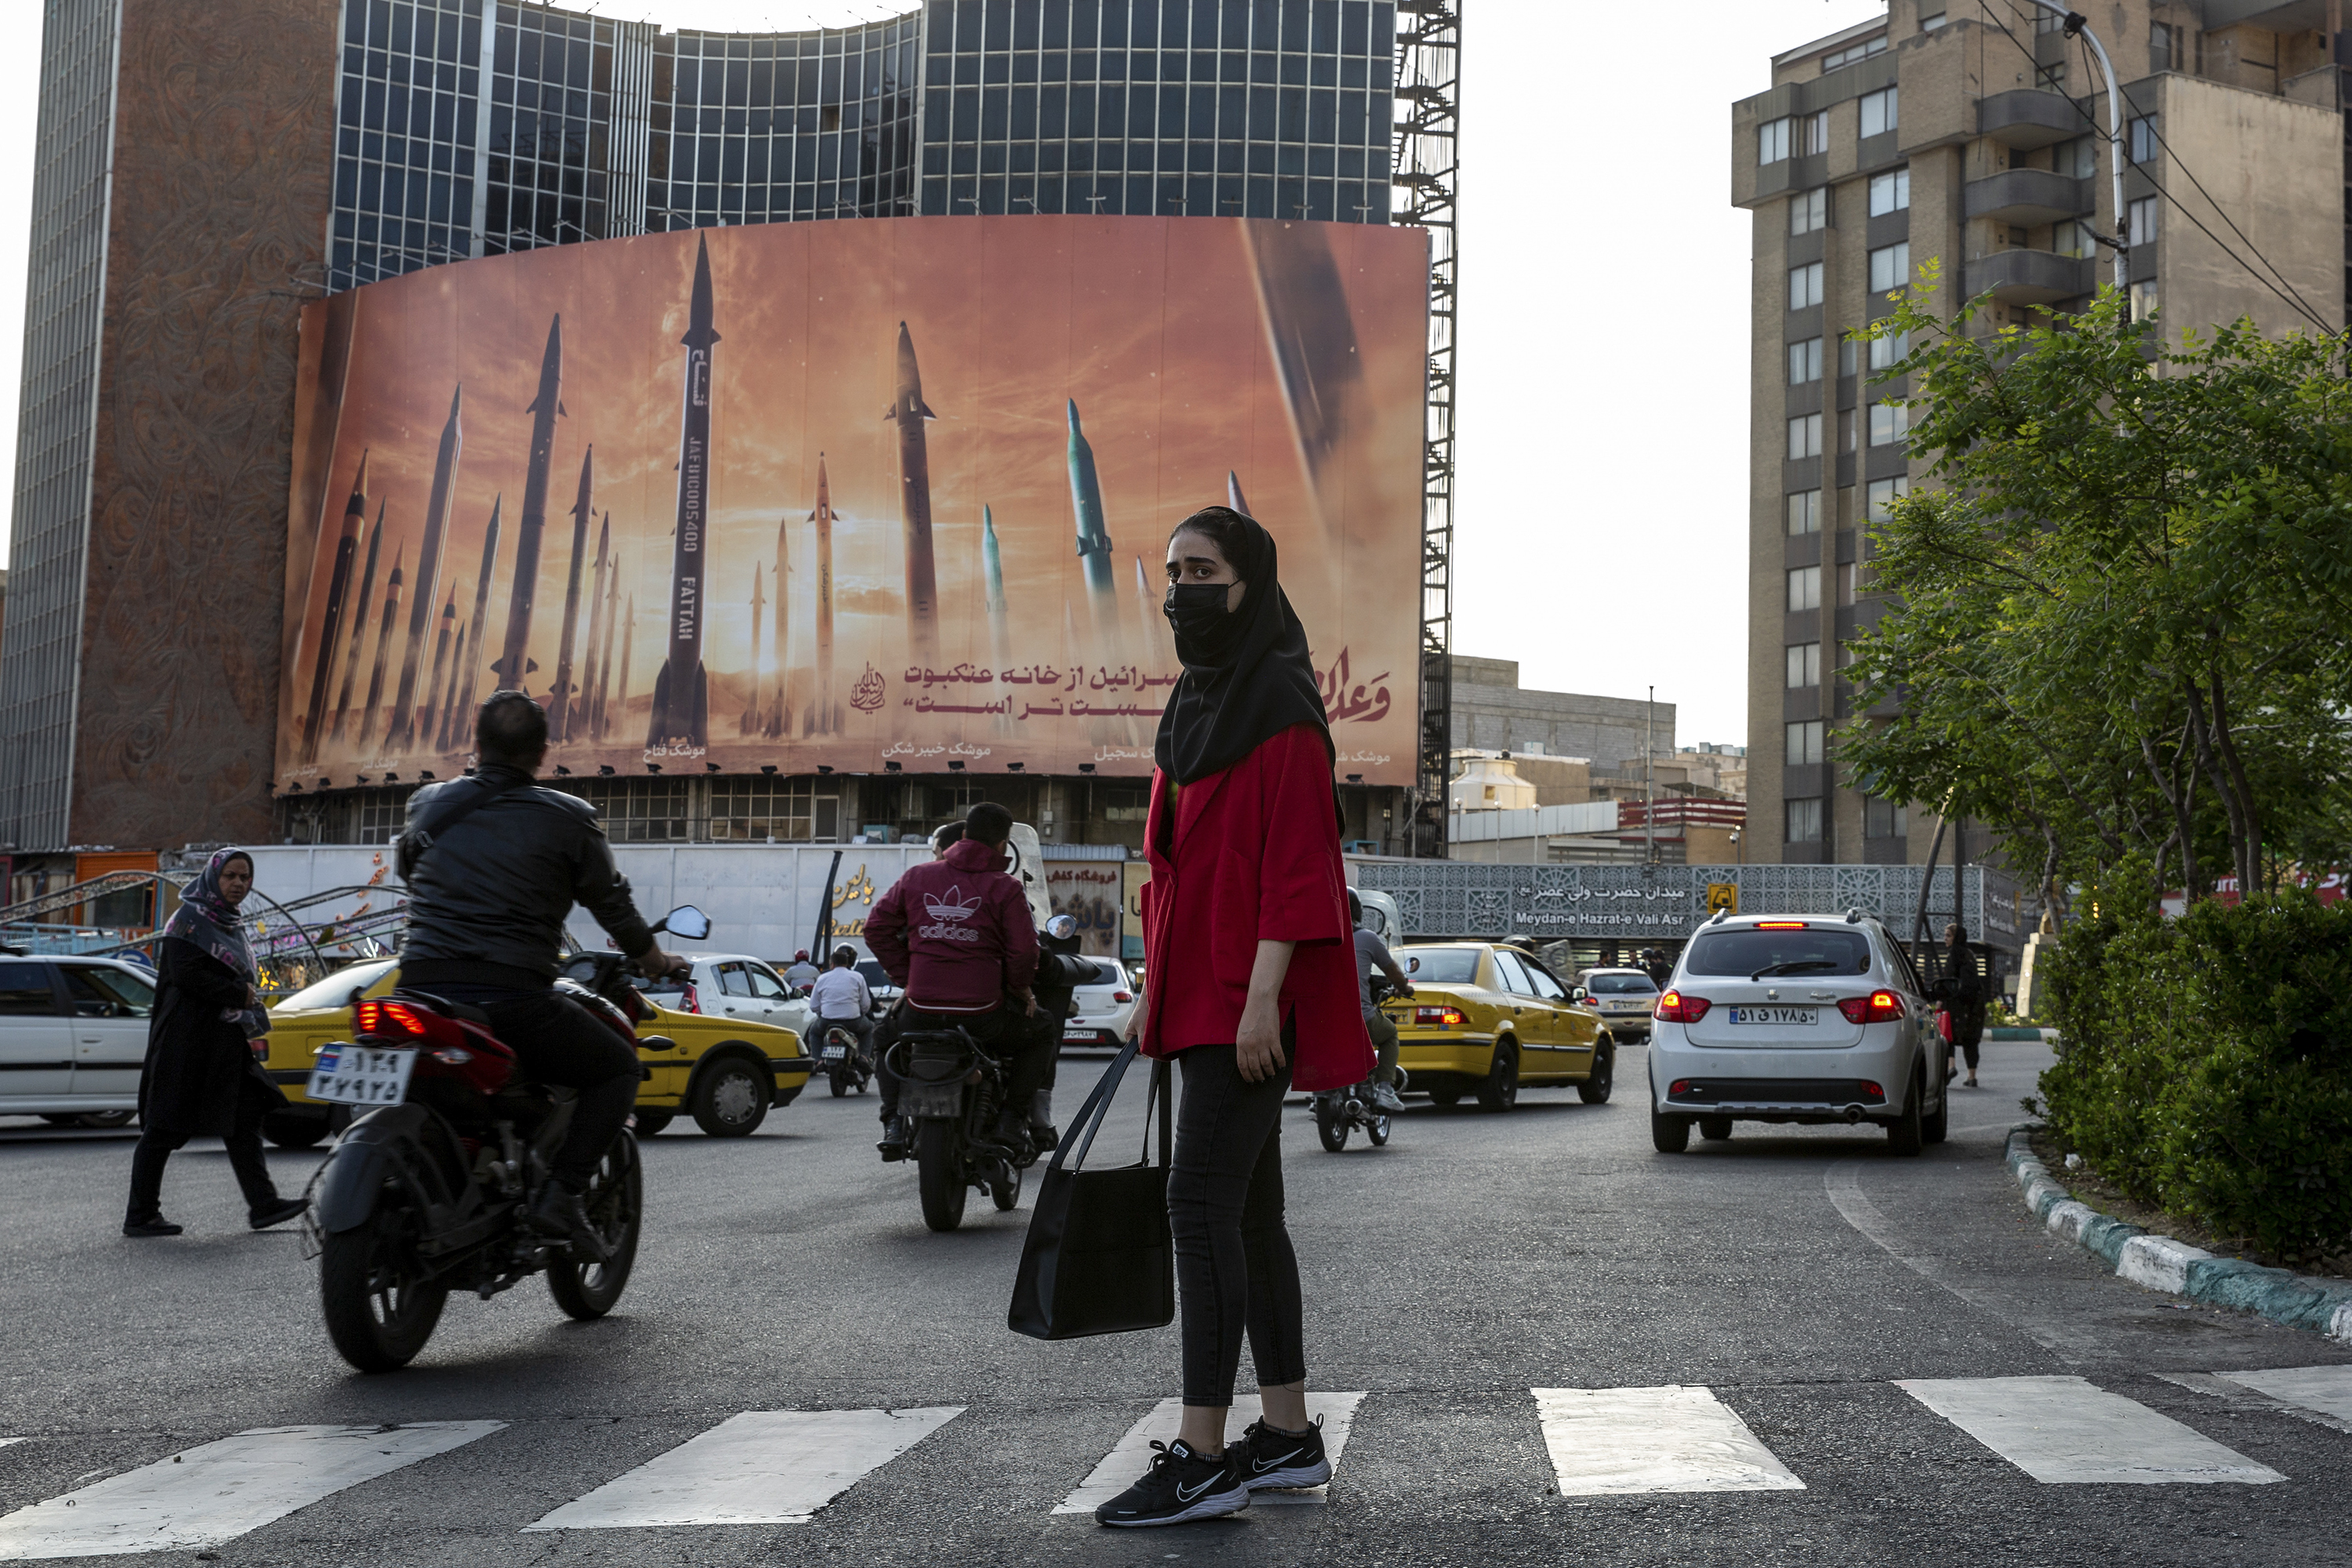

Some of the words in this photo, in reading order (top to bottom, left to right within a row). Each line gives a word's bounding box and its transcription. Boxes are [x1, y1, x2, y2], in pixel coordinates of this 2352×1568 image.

[679, 577, 695, 639] FATTAH
[904, 662, 993, 689] عنکبوت
[1000, 665, 1062, 684] خانه
[1065, 665, 1083, 691] از
[1090, 665, 1178, 692] سرائیل
[1018, 697, 1064, 720] تر
[643, 743, 667, 763] فتاح
[669, 744, 706, 759] موشک
[949, 742, 991, 759] موشک
[1094, 745, 1138, 761] سجیل
[1351, 750, 1391, 765] موشک
[1074, 869, 1117, 885] فروشگاه
[1534, 887, 1565, 901] عصر
[1568, 885, 1592, 902] ولی
[1594, 885, 1642, 901] حضرت
[1645, 885, 1686, 902] میدان
[1516, 913, 1577, 926] Meydan-e
[1580, 913, 1633, 925] Hazrat-e
[1635, 913, 1660, 925] Vali
[1661, 913, 1685, 926] Asr
[918, 922, 979, 942] adidas
